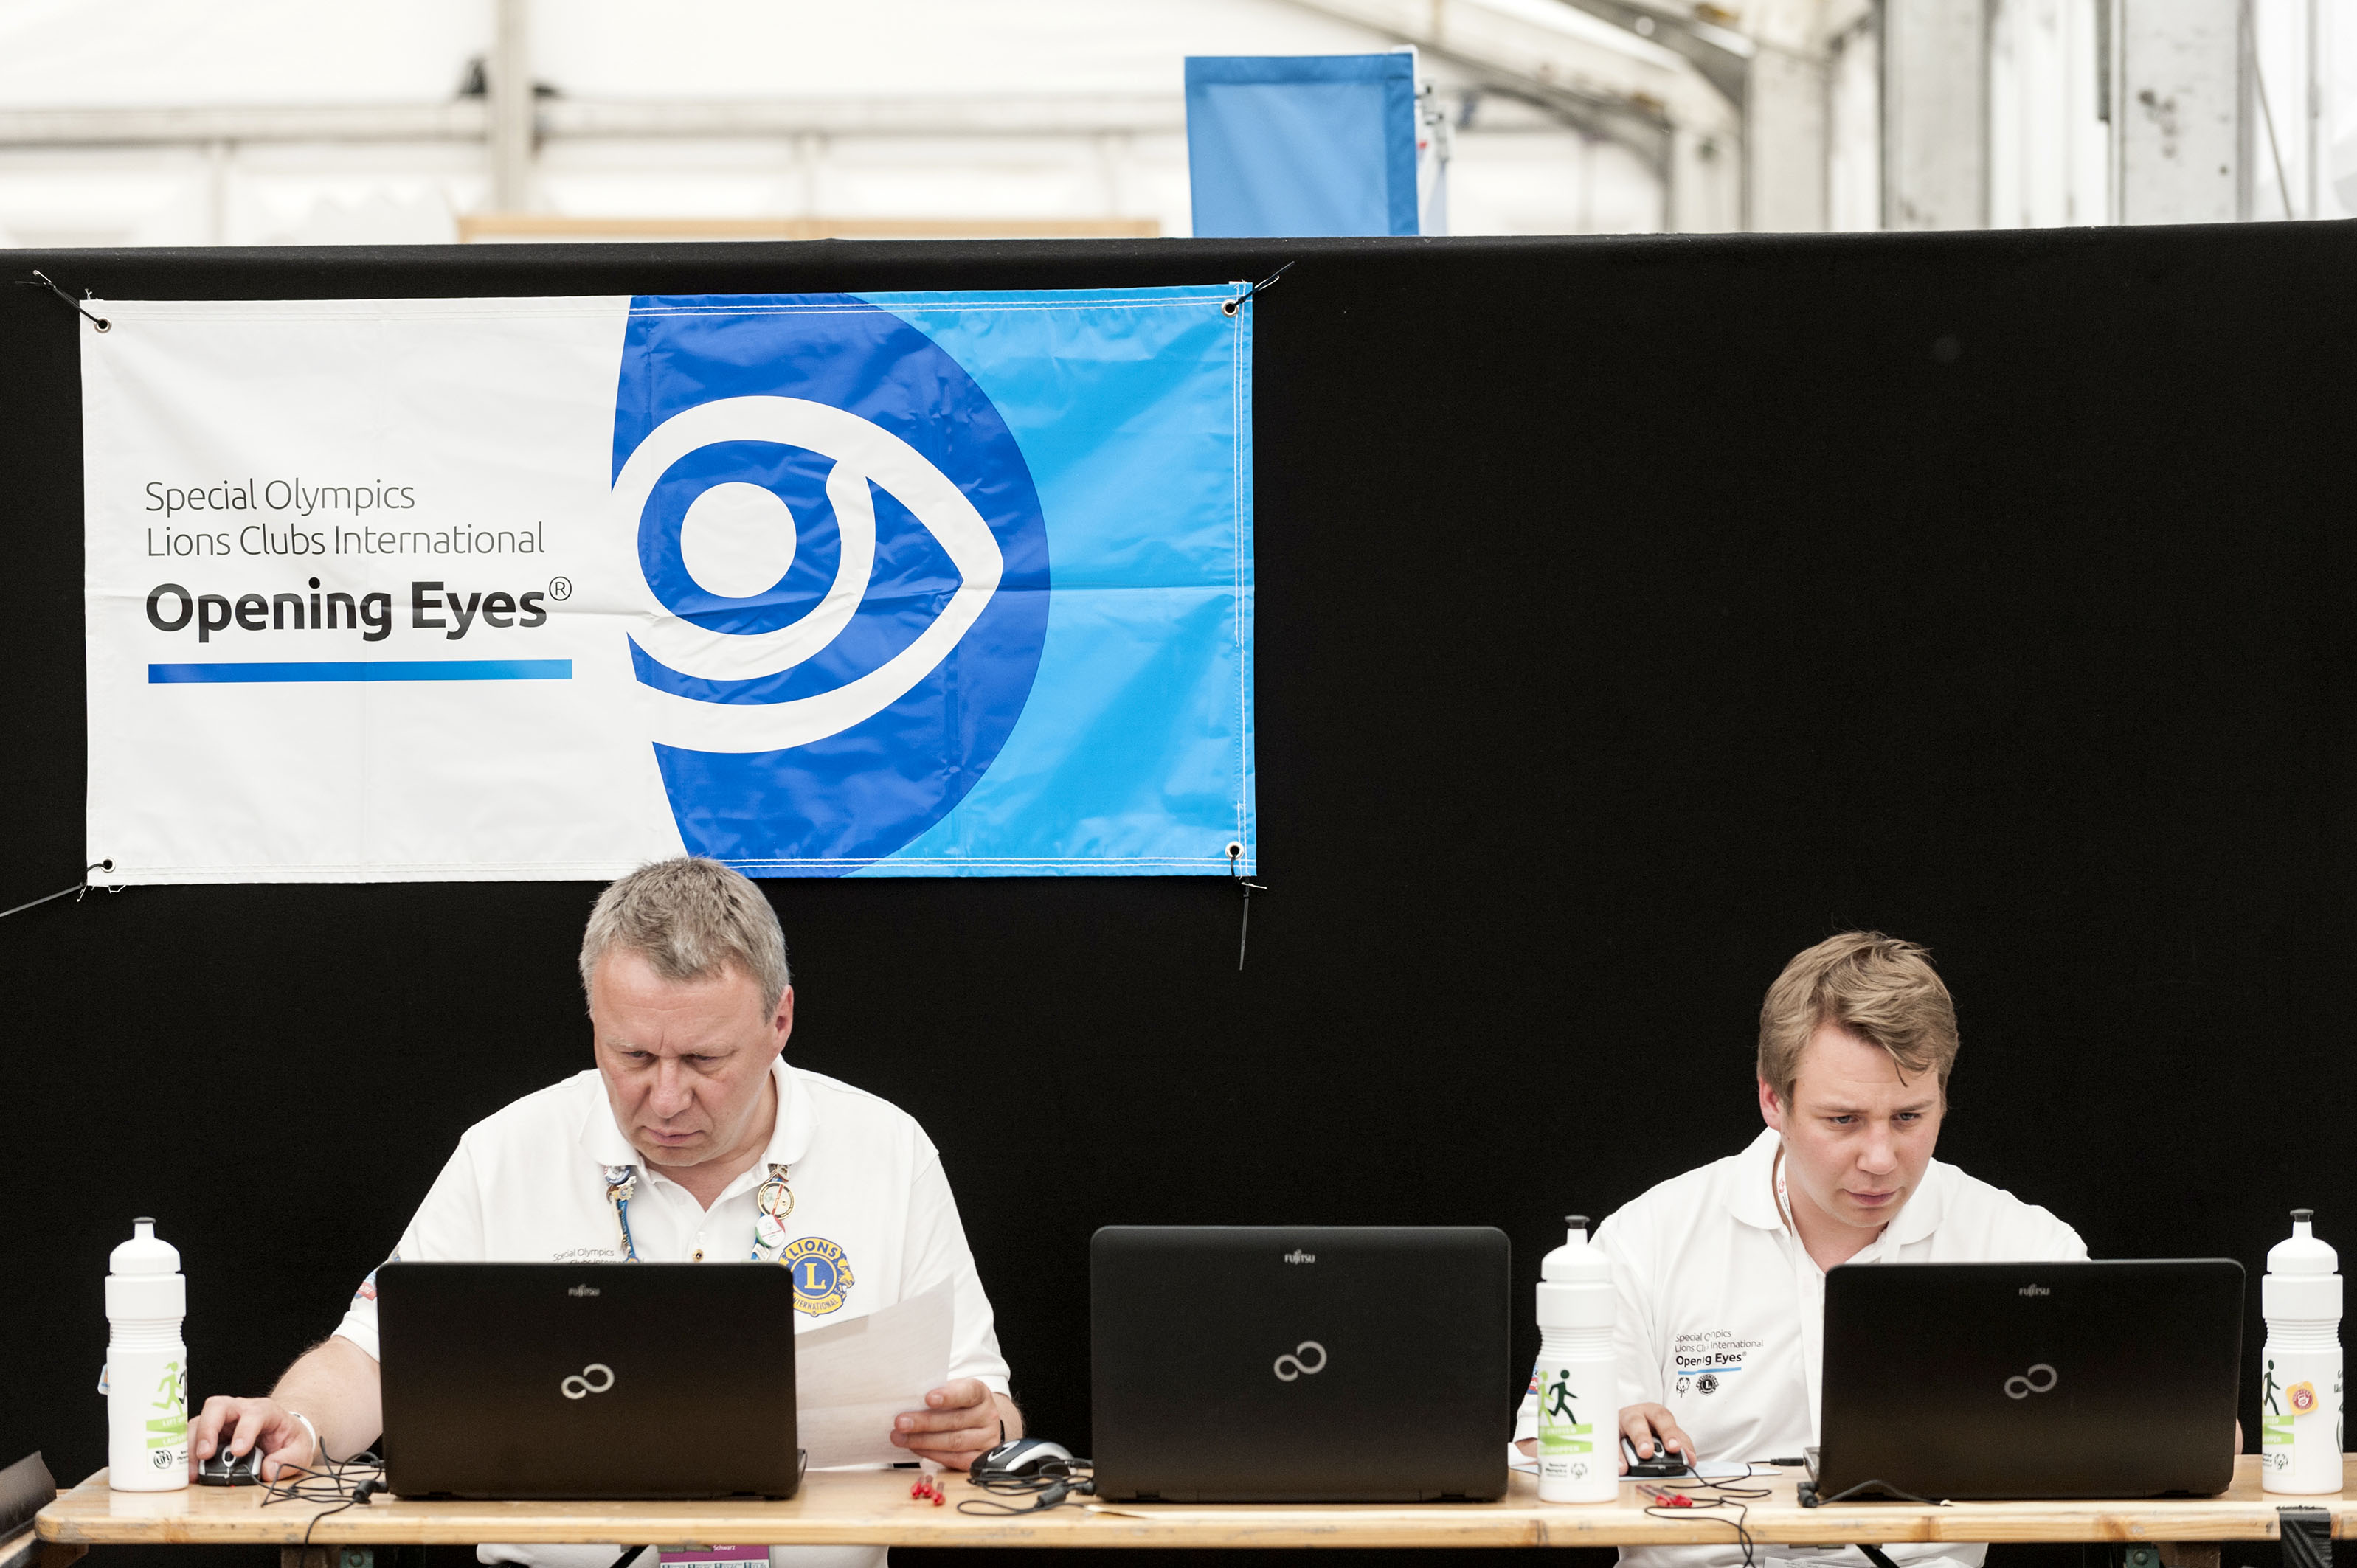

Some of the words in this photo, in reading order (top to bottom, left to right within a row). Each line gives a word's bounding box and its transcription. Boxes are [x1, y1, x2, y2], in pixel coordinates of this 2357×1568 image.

[145, 477, 257, 518] Special
[265, 478, 415, 517] Olympics
[148, 525, 232, 557] Lions
[240, 523, 326, 555] Clubs
[335, 521, 545, 555] International
[146, 577, 392, 643] Opening
[553, 1249, 576, 1262] Special
[577, 1247, 615, 1257] Olympics
[789, 1241, 838, 1257] LIONS
[1284, 1249, 1316, 1265] FUJITSU
[804, 1263, 826, 1289] L
[1675, 1344, 1695, 1353] Lions
[1711, 1339, 1764, 1350] International
